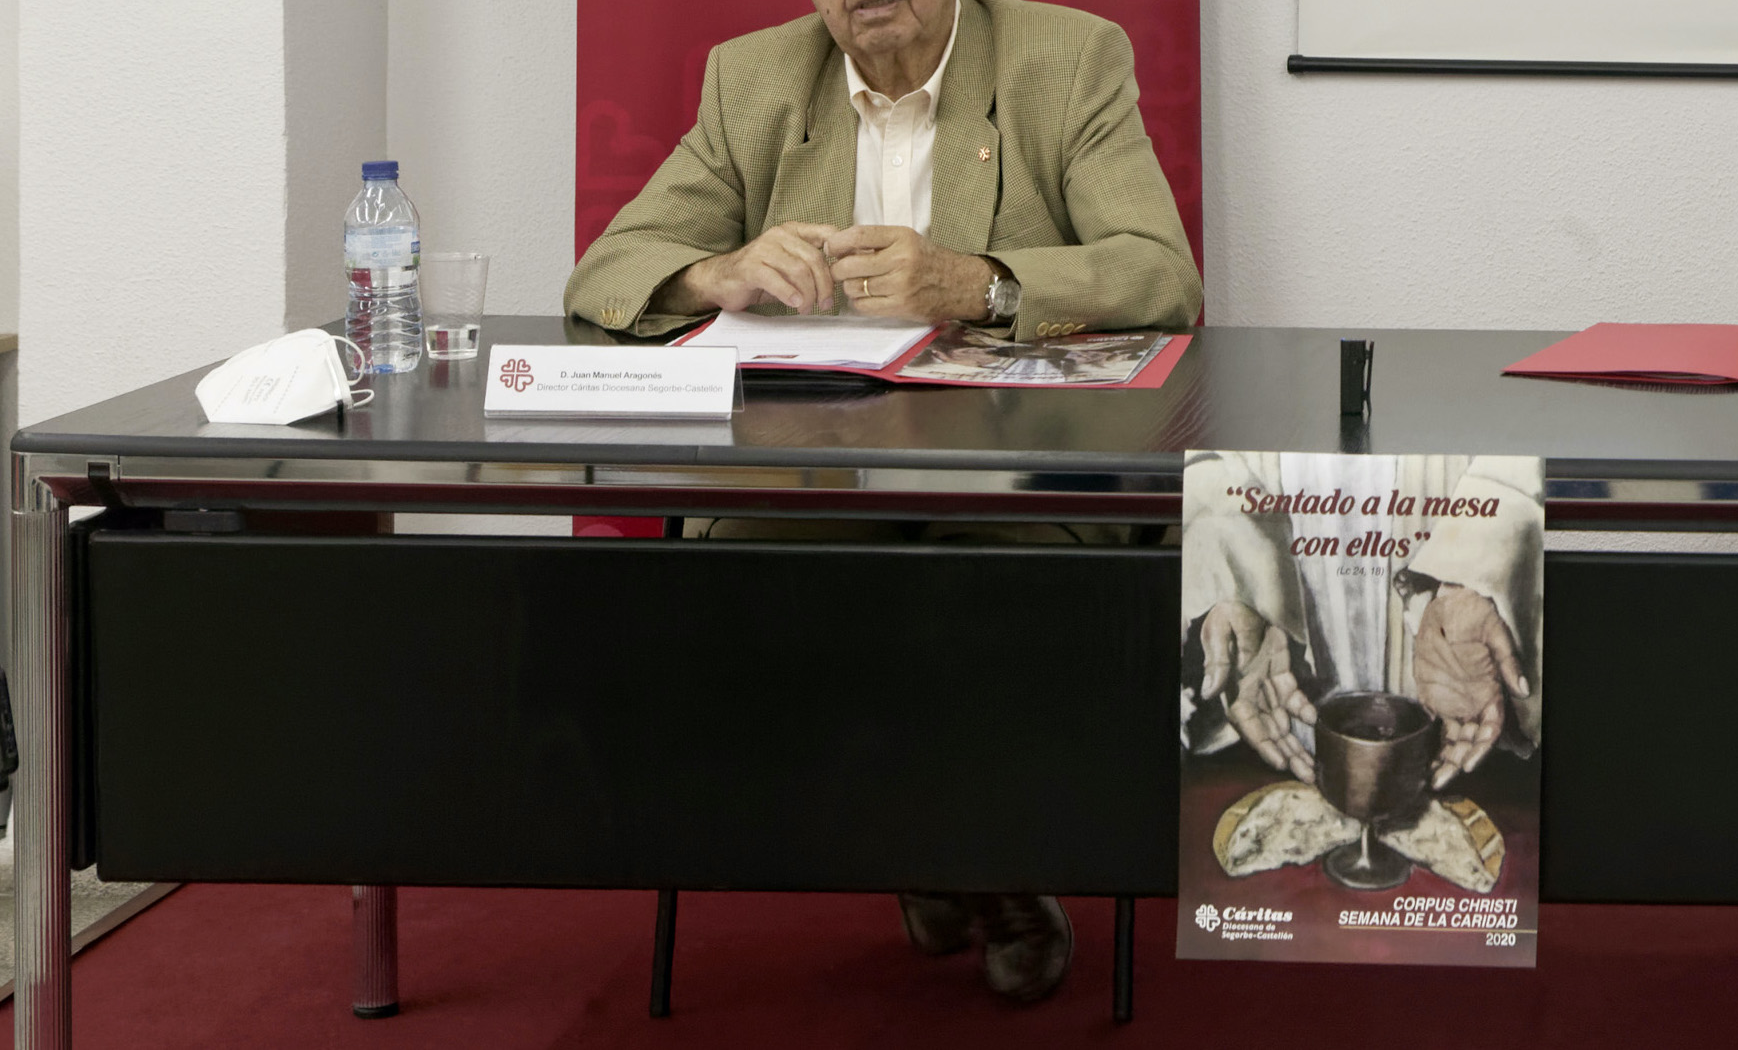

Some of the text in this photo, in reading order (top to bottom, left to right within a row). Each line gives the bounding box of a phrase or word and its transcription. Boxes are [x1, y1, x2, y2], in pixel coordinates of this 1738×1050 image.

[593, 371, 622, 379] Manuel
[624, 371, 662, 380] Aragonés
[536, 383, 568, 391] Director
[602, 384, 645, 392] Diocesana
[1227, 487, 1500, 517] “Sentado a la mesa
[1290, 531, 1430, 558] con ellos”
[1394, 897, 1517, 912] CORPUS CHRISTI
[1222, 906, 1293, 922] Cáritas
[1338, 911, 1518, 928] SEMANA DE LA CARIDAD
[1222, 922, 1276, 931] Diocesana de
[1222, 931, 1293, 940] Segorbe-Castellón
[1486, 933, 1516, 946] 2020
